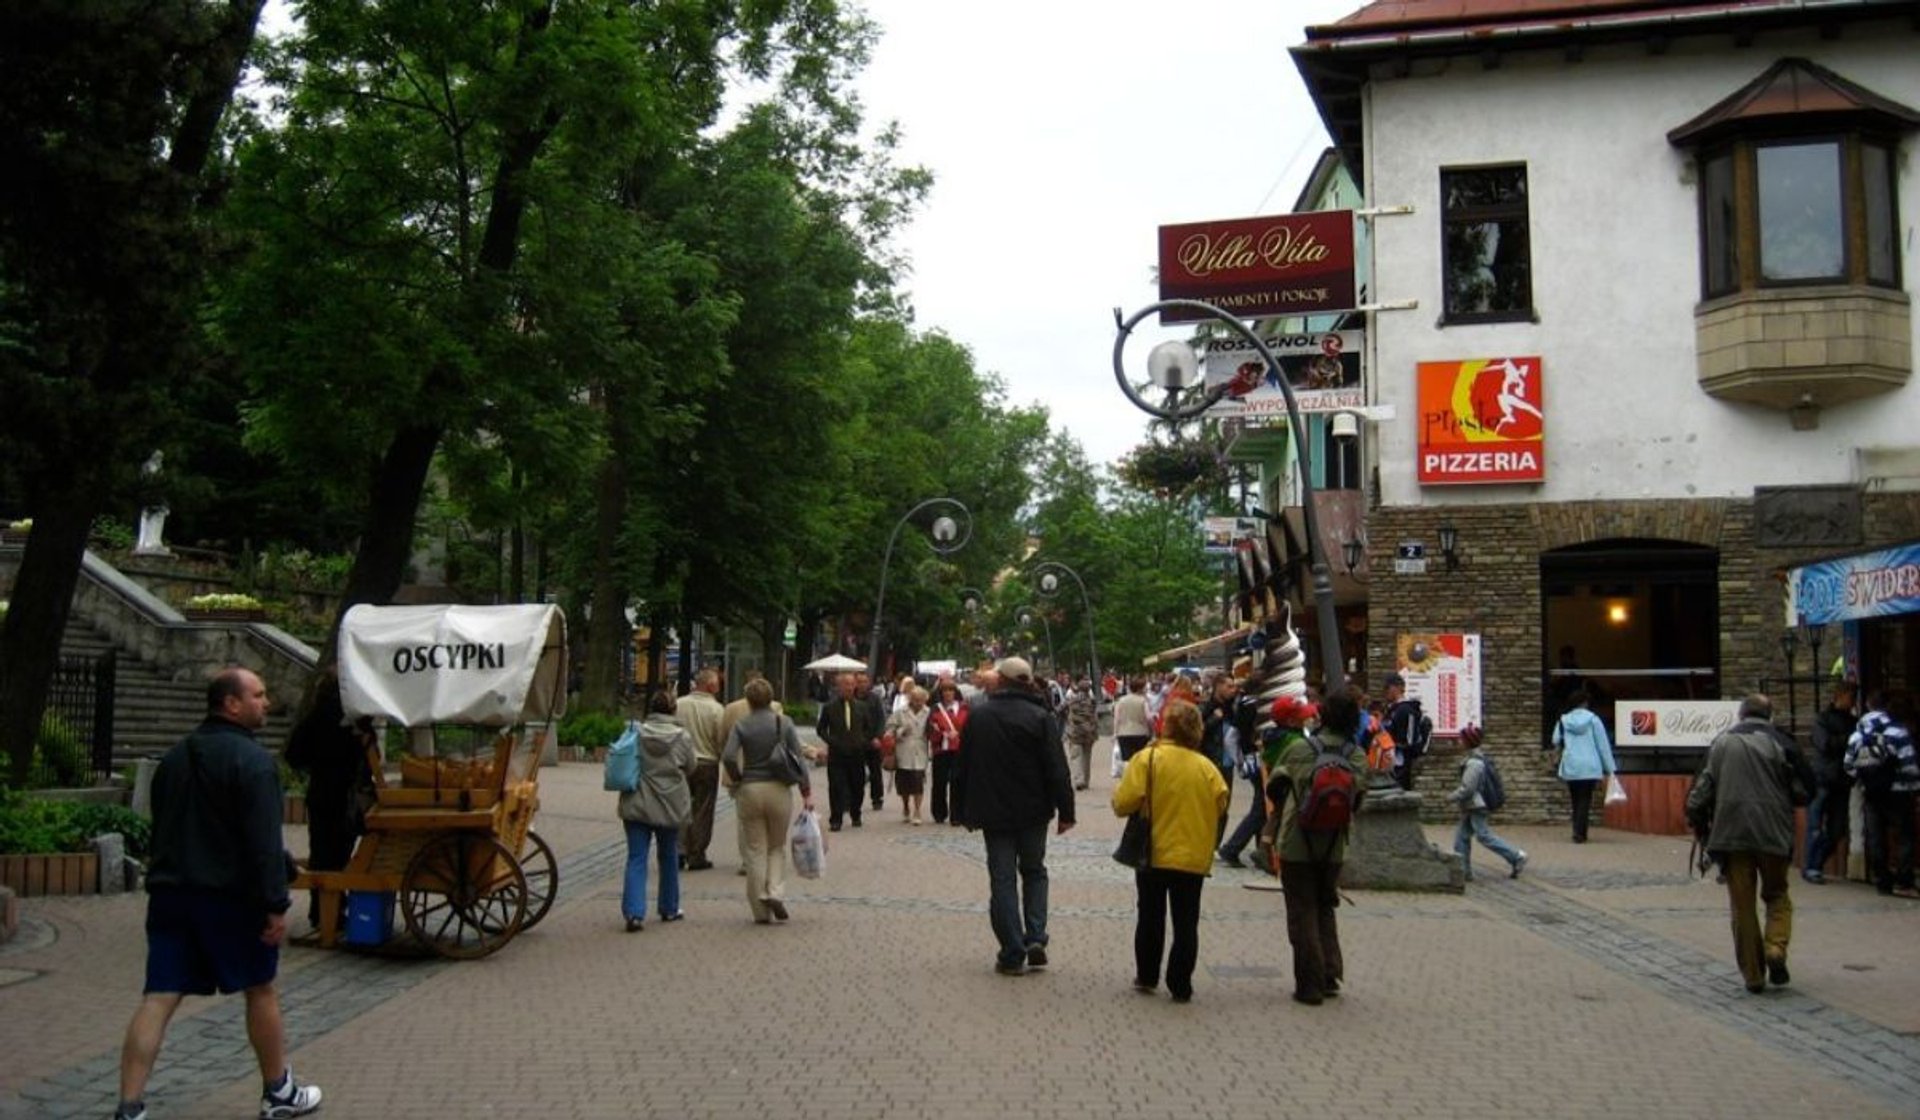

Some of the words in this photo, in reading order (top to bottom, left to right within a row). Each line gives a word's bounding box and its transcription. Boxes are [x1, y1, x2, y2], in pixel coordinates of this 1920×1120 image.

[1178, 231, 1258, 276] Villa
[1258, 223, 1330, 268] Vita
[1198, 293, 1272, 308] RTAMENTY
[1281, 288, 1330, 302] POKOJE
[1207, 334, 1319, 352] ROSSGNOL
[1246, 394, 1361, 411] WYPOCZALNIA
[1424, 451, 1537, 473] PIZZERIA
[1407, 546, 1416, 558] 2
[1845, 564, 1920, 608] ŚWIDER
[393, 642, 505, 674] OSCYPKI
[1664, 709, 1713, 737] Villa
